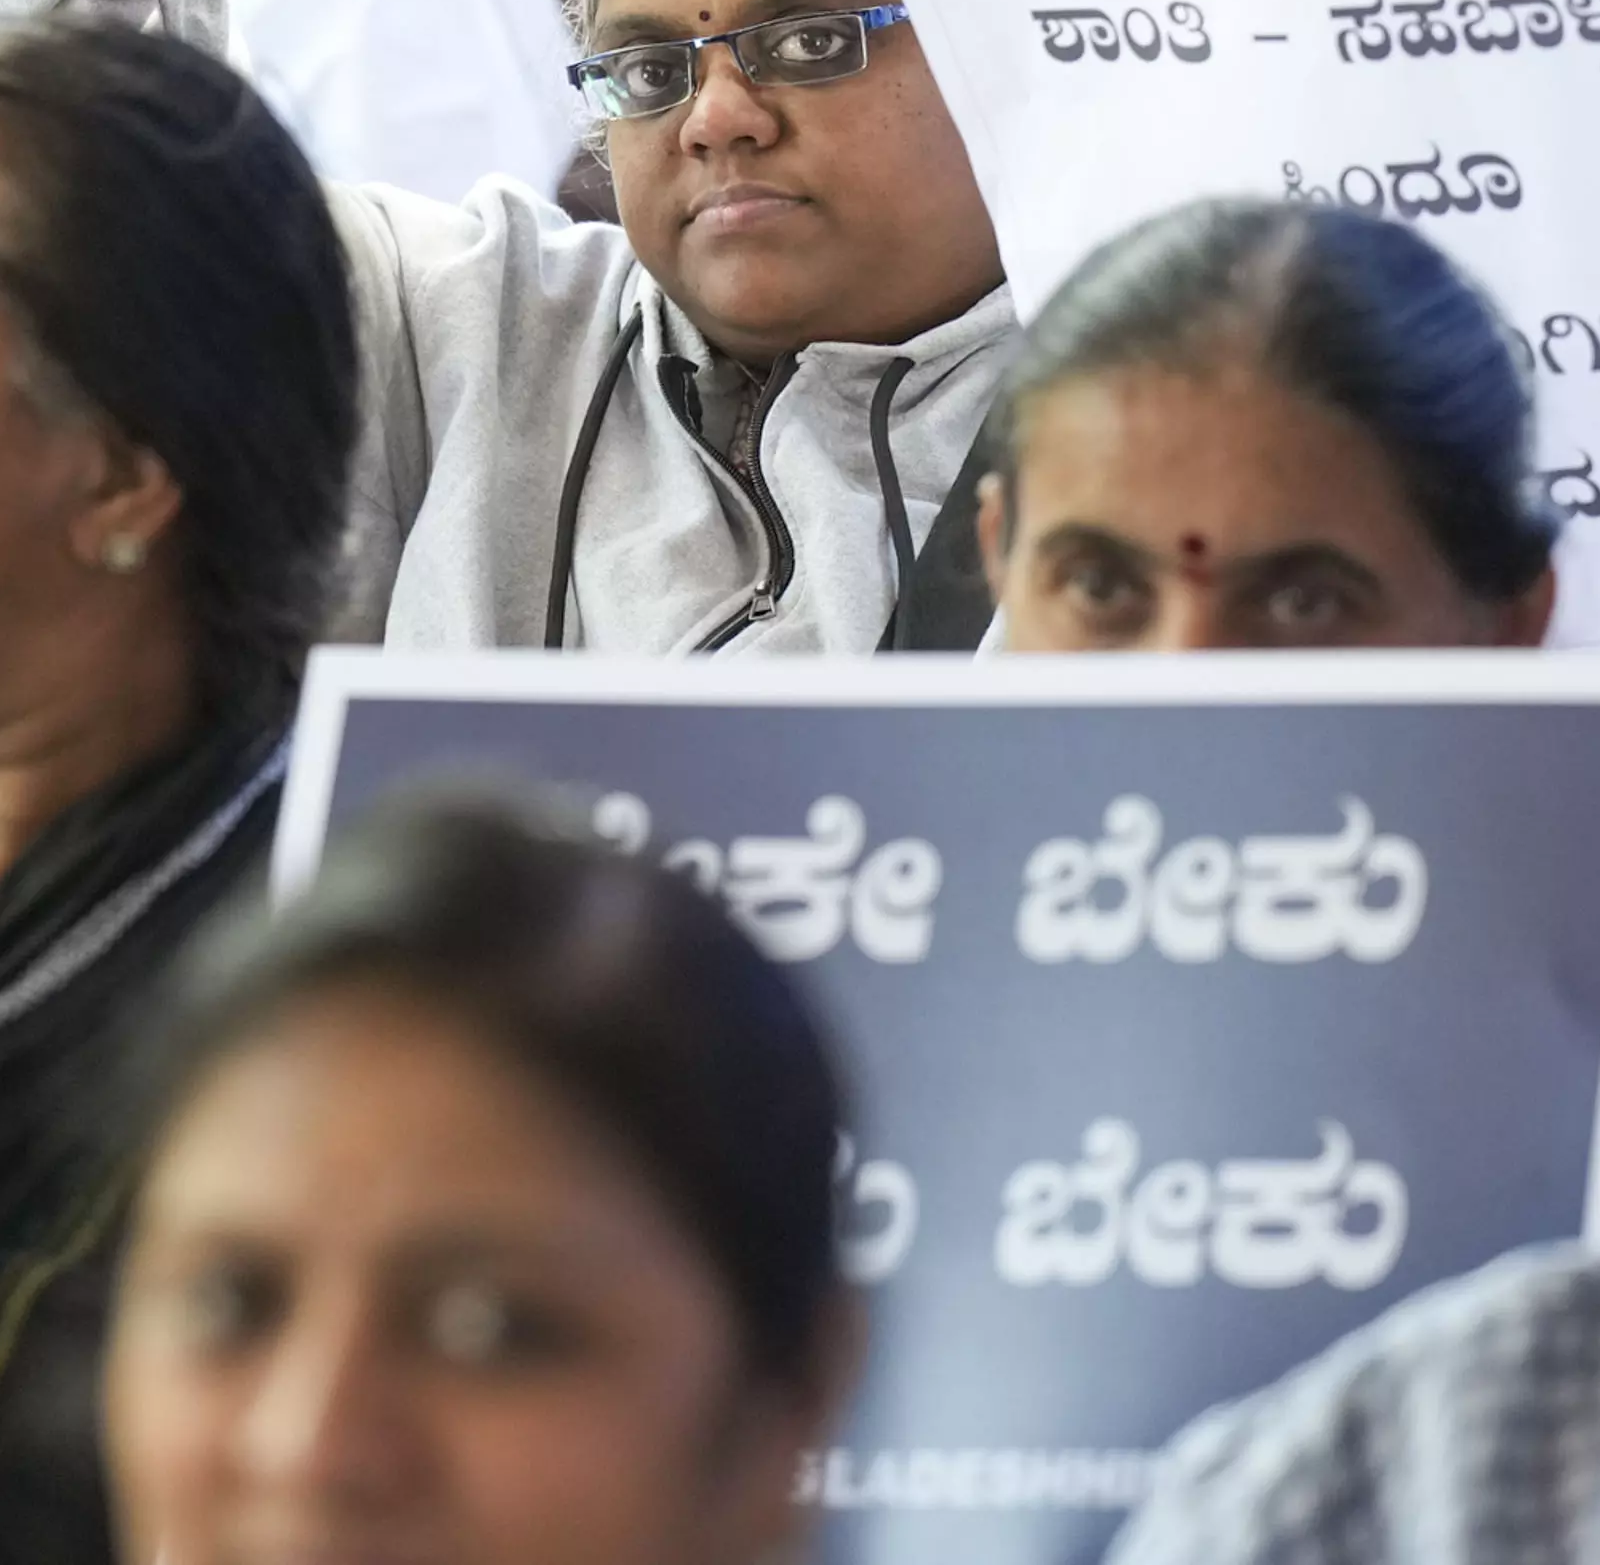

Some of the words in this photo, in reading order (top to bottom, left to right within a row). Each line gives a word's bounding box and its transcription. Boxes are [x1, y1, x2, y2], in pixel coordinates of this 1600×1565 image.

[1030, 1, 1213, 64] ಶಾಂತಿ
[1016, 794, 1428, 964] ಬೇಕು
[994, 1116, 1410, 1291] ಬೇಕು
